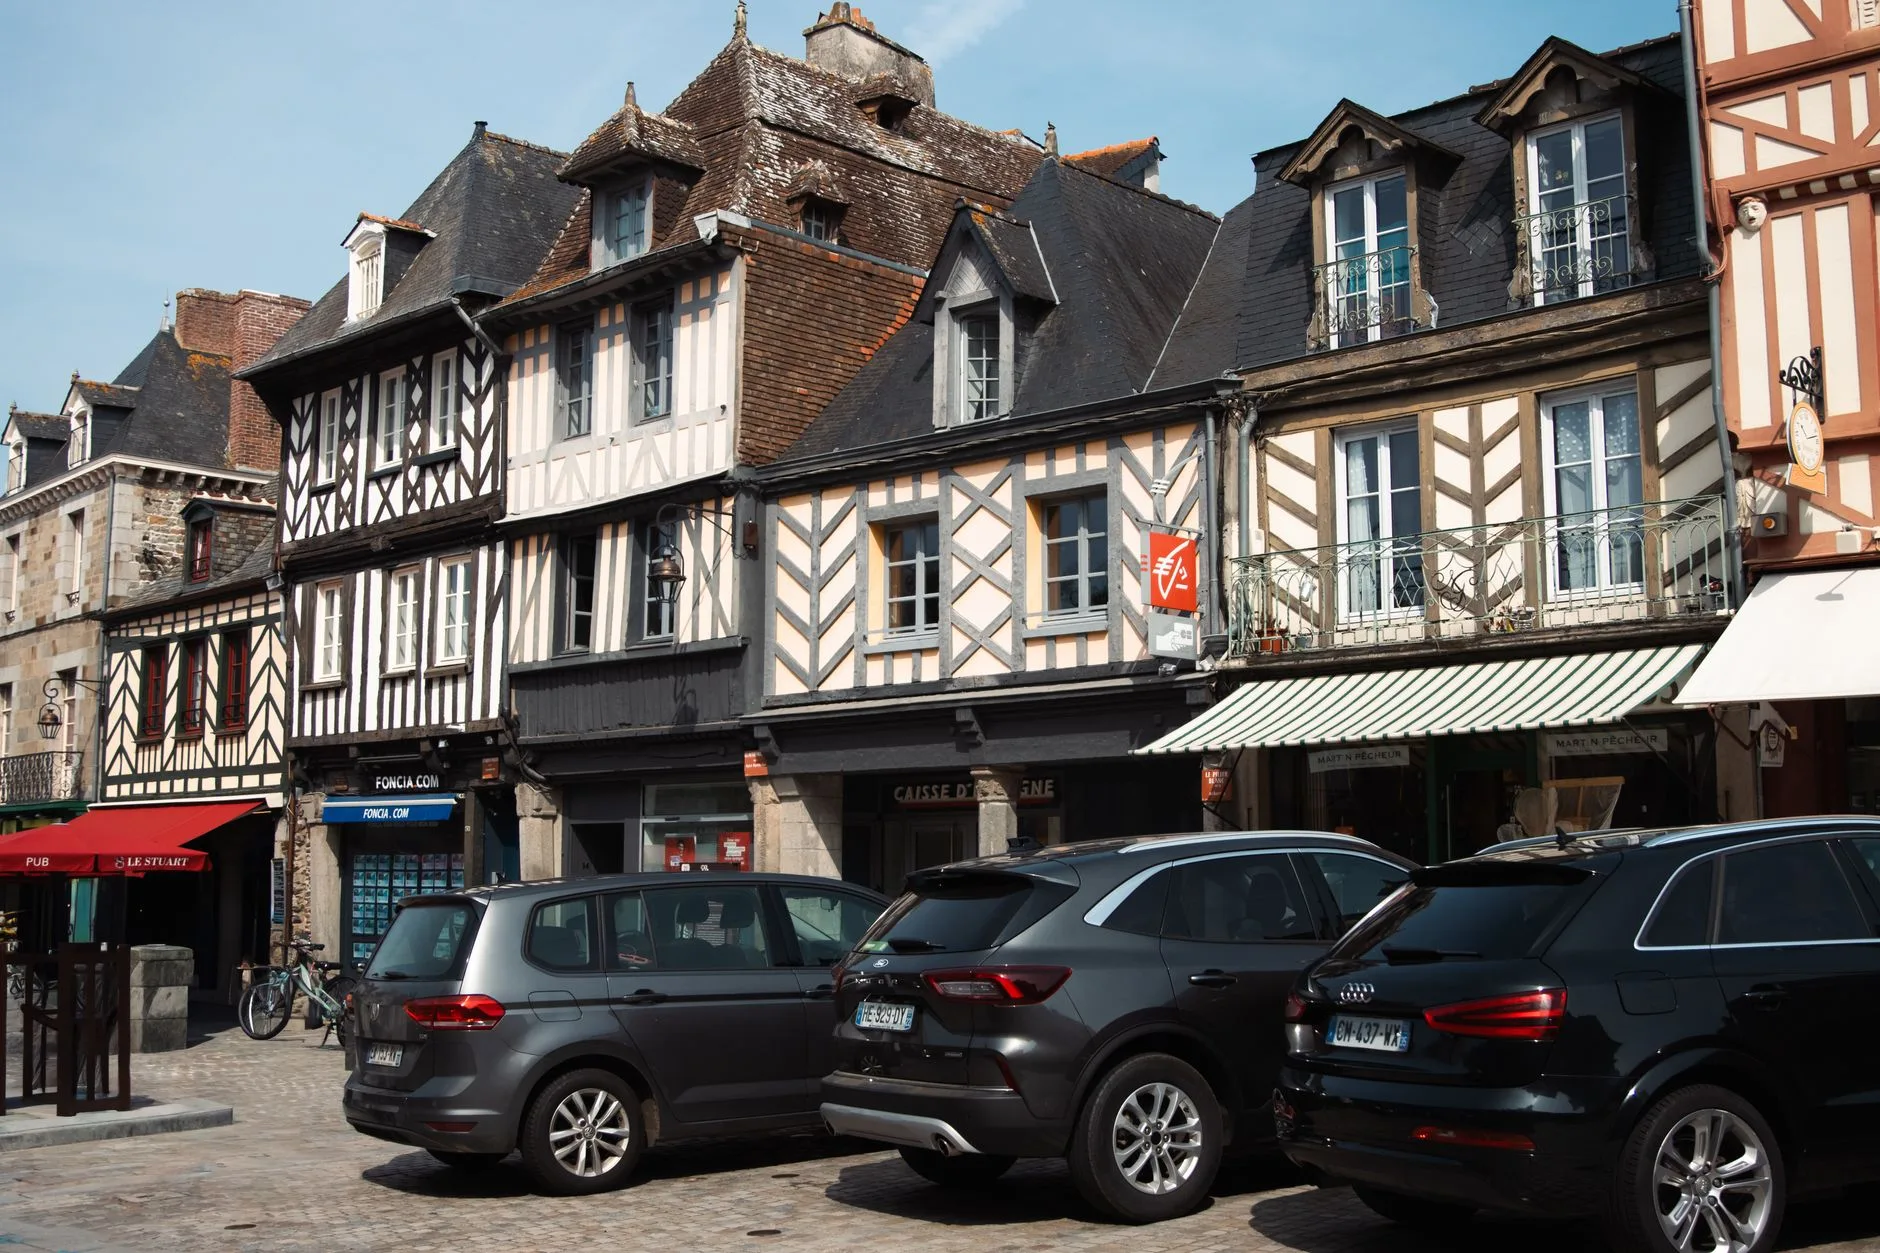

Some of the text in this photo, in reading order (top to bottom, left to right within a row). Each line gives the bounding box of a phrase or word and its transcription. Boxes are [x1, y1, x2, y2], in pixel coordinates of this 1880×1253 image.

[1556, 738, 1598, 748] MARTN
[1317, 753, 1352, 764] MARTN
[893, 783, 950, 801] CAISSE
[26, 857, 50, 867] PUB
[127, 856, 142, 867] LE
[144, 856, 189, 867] STUART
[862, 1004, 906, 1025] HE-929-DY
